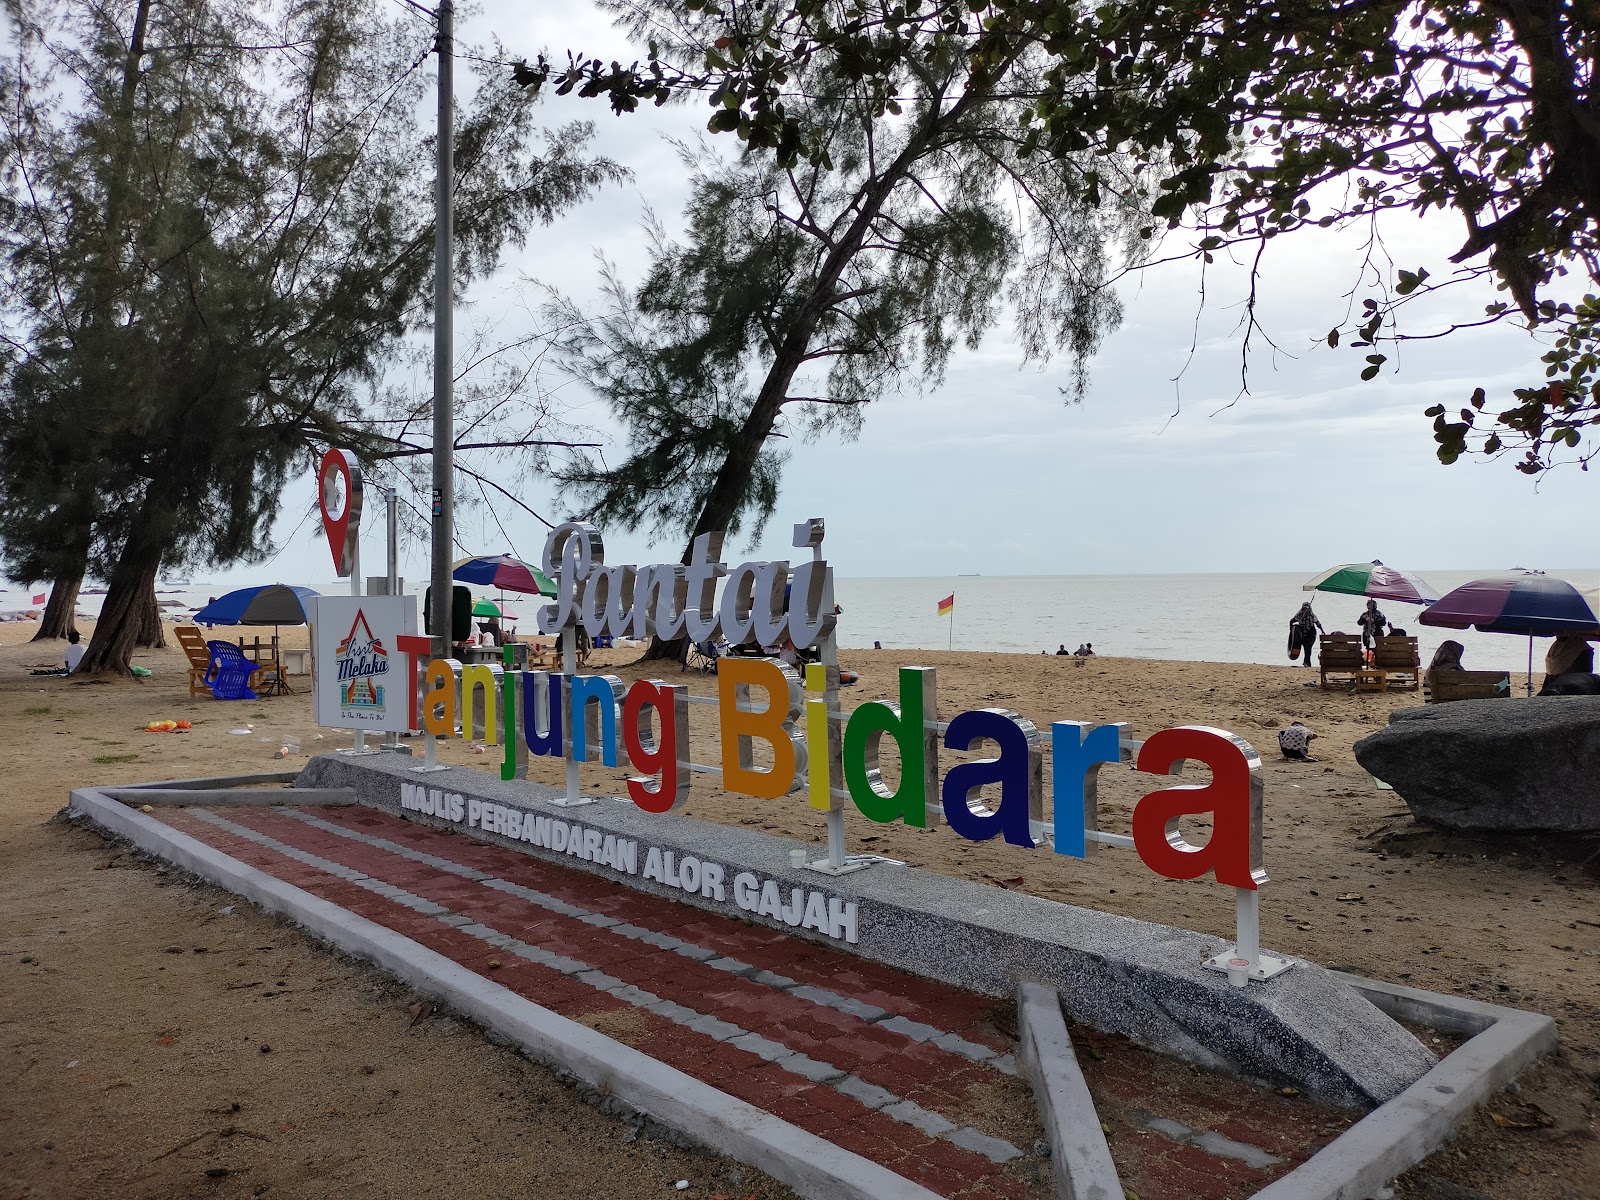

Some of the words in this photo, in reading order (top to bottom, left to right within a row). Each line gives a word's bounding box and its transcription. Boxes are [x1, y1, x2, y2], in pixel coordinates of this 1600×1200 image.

[345, 637, 380, 658] Visit
[537, 518, 837, 650] Pantai
[336, 653, 389, 681] Melaka
[397, 635, 684, 814] Tanjung
[717, 656, 1264, 891] Bidara
[401, 782, 465, 823] MAJLIS
[468, 800, 638, 875] PERBANDARAN
[643, 847, 726, 902] ALOR
[733, 872, 859, 944] GAJAH
